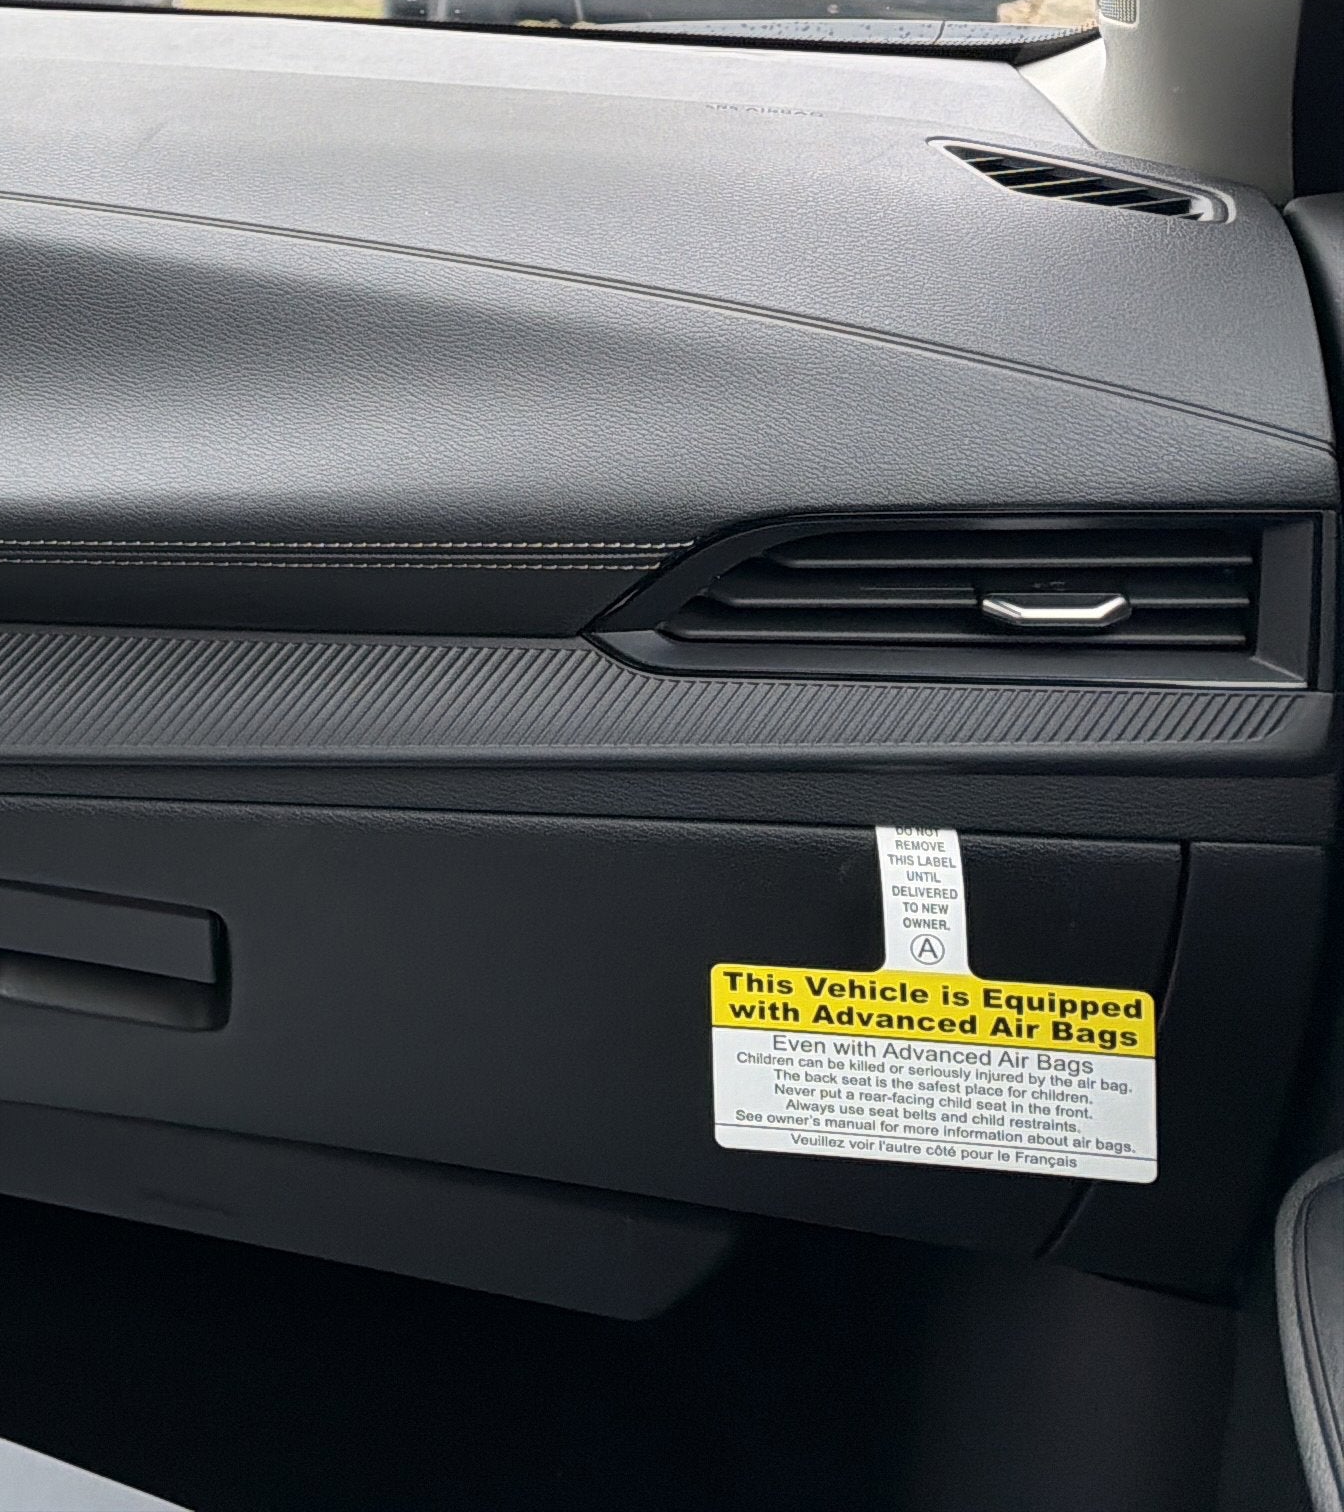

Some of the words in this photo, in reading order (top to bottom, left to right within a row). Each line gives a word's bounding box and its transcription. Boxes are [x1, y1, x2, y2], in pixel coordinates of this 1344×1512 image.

[887, 854, 914, 866] THIS
[917, 856, 957, 868] LABEL
[895, 840, 946, 852] REMOVE
[892, 885, 959, 900] DELIVERED
[906, 871, 941, 883] UNTIL
[902, 902, 919, 914] TO
[922, 904, 949, 915] NEW
[903, 917, 951, 931] OWNER.
[722, 970, 794, 995] This
[805, 976, 929, 1003] Vehicle
[941, 984, 970, 1008] is
[983, 988, 1142, 1020] Equipped
[728, 999, 801, 1023] with
[812, 1004, 977, 1035] Advanced
[988, 1015, 1041, 1040] Air
[1052, 1020, 1138, 1050] Bags
[735, 1050, 795, 1068] Children
[796, 1057, 824, 1070] can
[826, 1056, 846, 1071] be
[848, 1058, 886, 1075] killed
[888, 1063, 905, 1076] or
[907, 1064, 973, 1083] seriously
[974, 1067, 1025, 1085] injured
[1027, 1071, 1047, 1090] by
[1048, 1073, 1075, 1089] the
[1072, 1074, 1098, 1091] air
[1099, 1076, 1133, 1096] bag.
[772, 1033, 827, 1055] Even
[831, 1039, 877, 1059] with
[881, 1041, 993, 1067] Advanced
[996, 1049, 1030, 1070] Air
[1036, 1052, 1095, 1077] Bags
[772, 1067, 802, 1083] The
[803, 1069, 839, 1086] back
[840, 1074, 873, 1088] seat
[874, 1074, 888, 1089] is
[890, 1076, 915, 1092] the
[916, 1078, 962, 1095] safest
[964, 1081, 1005, 1098] place
[1006, 1084, 1029, 1100] for
[1029, 1087, 1094, 1106] children.
[773, 1082, 817, 1099] Never
[818, 1087, 843, 1101] put
[844, 1089, 856, 1101] a
[858, 1090, 936, 1110] rear-facing
[937, 1095, 973, 1110] child
[975, 1099, 1008, 1113] seat
[1009, 1099, 1025, 1115] in
[1027, 1101, 1052, 1117] the
[1054, 1103, 1094, 1120] front.
[734, 1108, 764, 1124] See
[765, 1112, 824, 1128] owner's
[823, 1117, 877, 1132] manual
[879, 1119, 901, 1134] for
[902, 1123, 940, 1138] more
[942, 1124, 1024, 1144] information
[1026, 1131, 1070, 1149] about
[1071, 1135, 1093, 1150] air
[1094, 1136, 1137, 1156] bags.
[784, 1097, 836, 1115] Always
[838, 1103, 866, 1117] use
[867, 1105, 900, 1120] seat
[901, 1106, 938, 1123] belts
[939, 1111, 969, 1125] and
[970, 1111, 1006, 1128] child
[1008, 1116, 1082, 1135] restraints.
[789, 1132, 846, 1150] Veuillez
[847, 1138, 876, 1152] voir
[877, 1136, 923, 1156] l'autre
[924, 1143, 957, 1159] côté
[959, 1148, 995, 1162] pour
[996, 1148, 1011, 1163] le
[1014, 1149, 1079, 1170] Français
